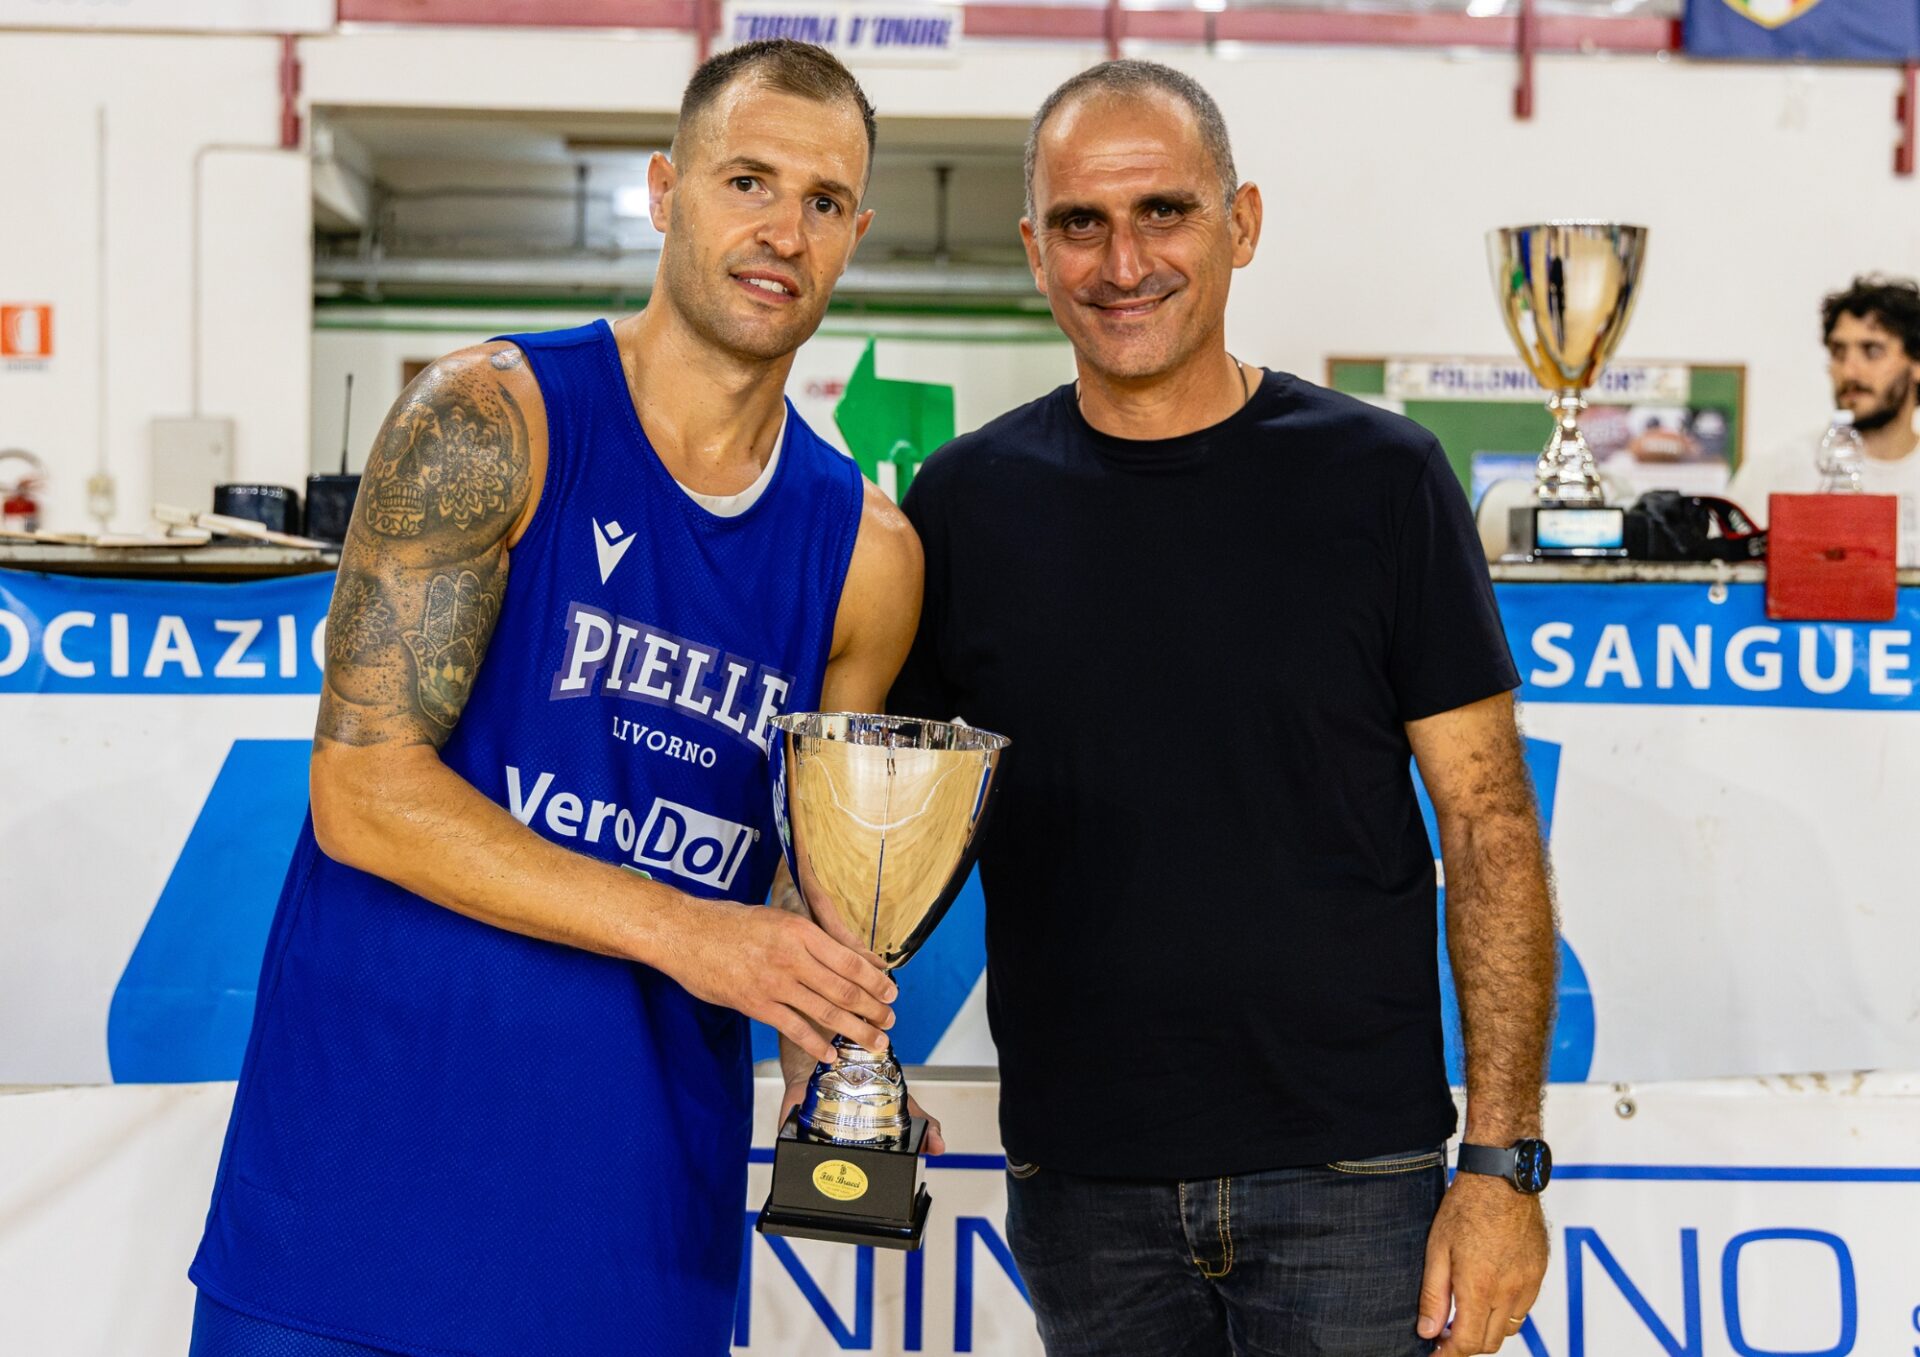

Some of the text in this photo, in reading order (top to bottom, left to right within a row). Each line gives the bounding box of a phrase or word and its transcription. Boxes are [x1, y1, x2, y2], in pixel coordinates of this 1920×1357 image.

[0, 608, 329, 679] CIAZI
[1529, 621, 1912, 695] SANGUE
[559, 609, 790, 756] PIELLE
[612, 715, 717, 769] LIVORNO
[1519, 1226, 1858, 1357] NO
